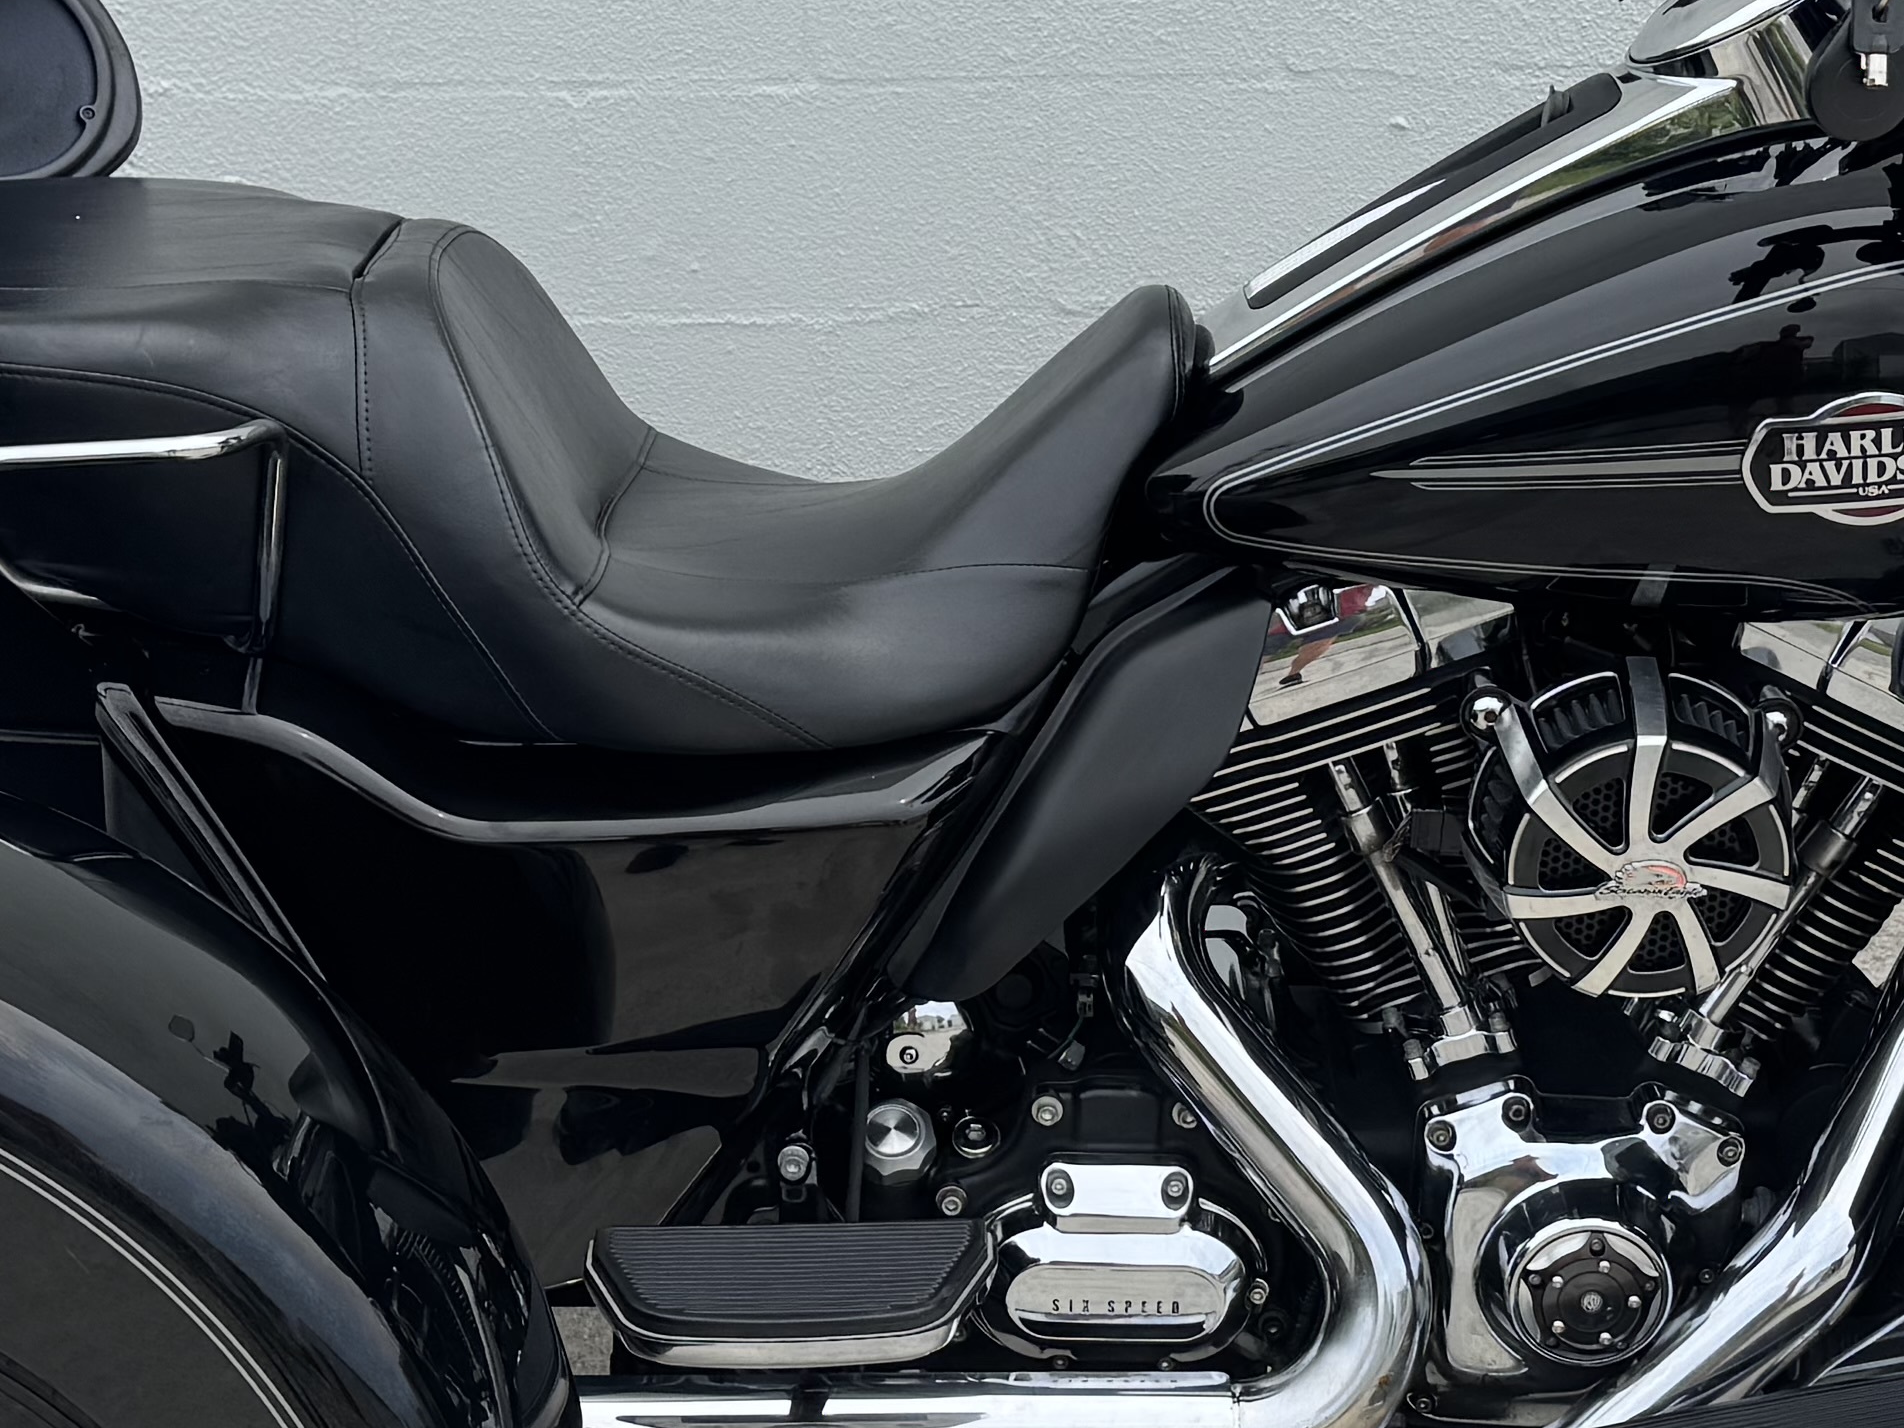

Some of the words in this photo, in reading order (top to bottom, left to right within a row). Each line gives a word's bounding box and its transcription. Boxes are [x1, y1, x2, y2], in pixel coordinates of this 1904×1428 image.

[1858, 483, 1890, 497] USA
[1052, 1298, 1090, 1313] SIX
[1107, 1299, 1181, 1315] SPEED
